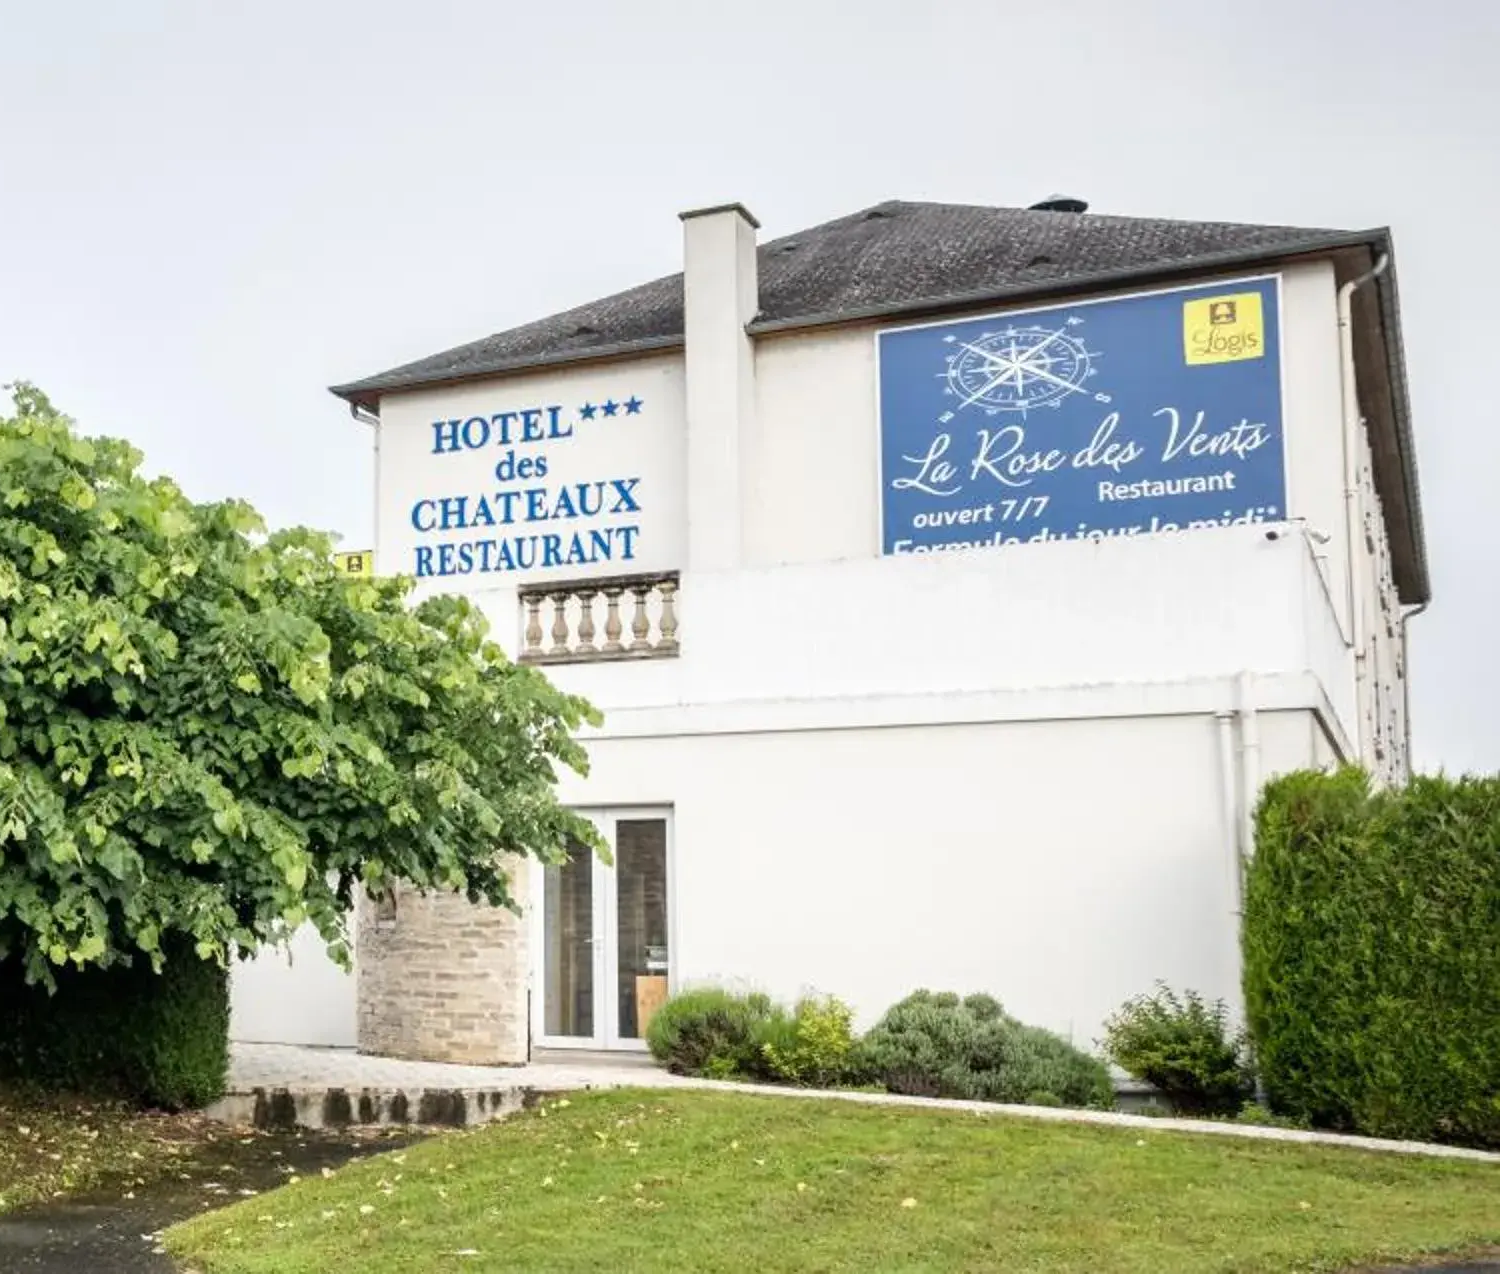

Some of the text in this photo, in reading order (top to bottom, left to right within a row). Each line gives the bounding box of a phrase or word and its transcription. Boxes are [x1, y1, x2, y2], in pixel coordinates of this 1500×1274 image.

[431, 405, 573, 454] HOTEL
[892, 407, 1271, 496] La Rose des Vents
[495, 450, 548, 482] des
[1099, 471, 1236, 501] Restaurant
[411, 478, 642, 532] CHATEAUX
[913, 496, 1050, 528] ouvert 7/7
[414, 526, 639, 578] RESTAURANT
